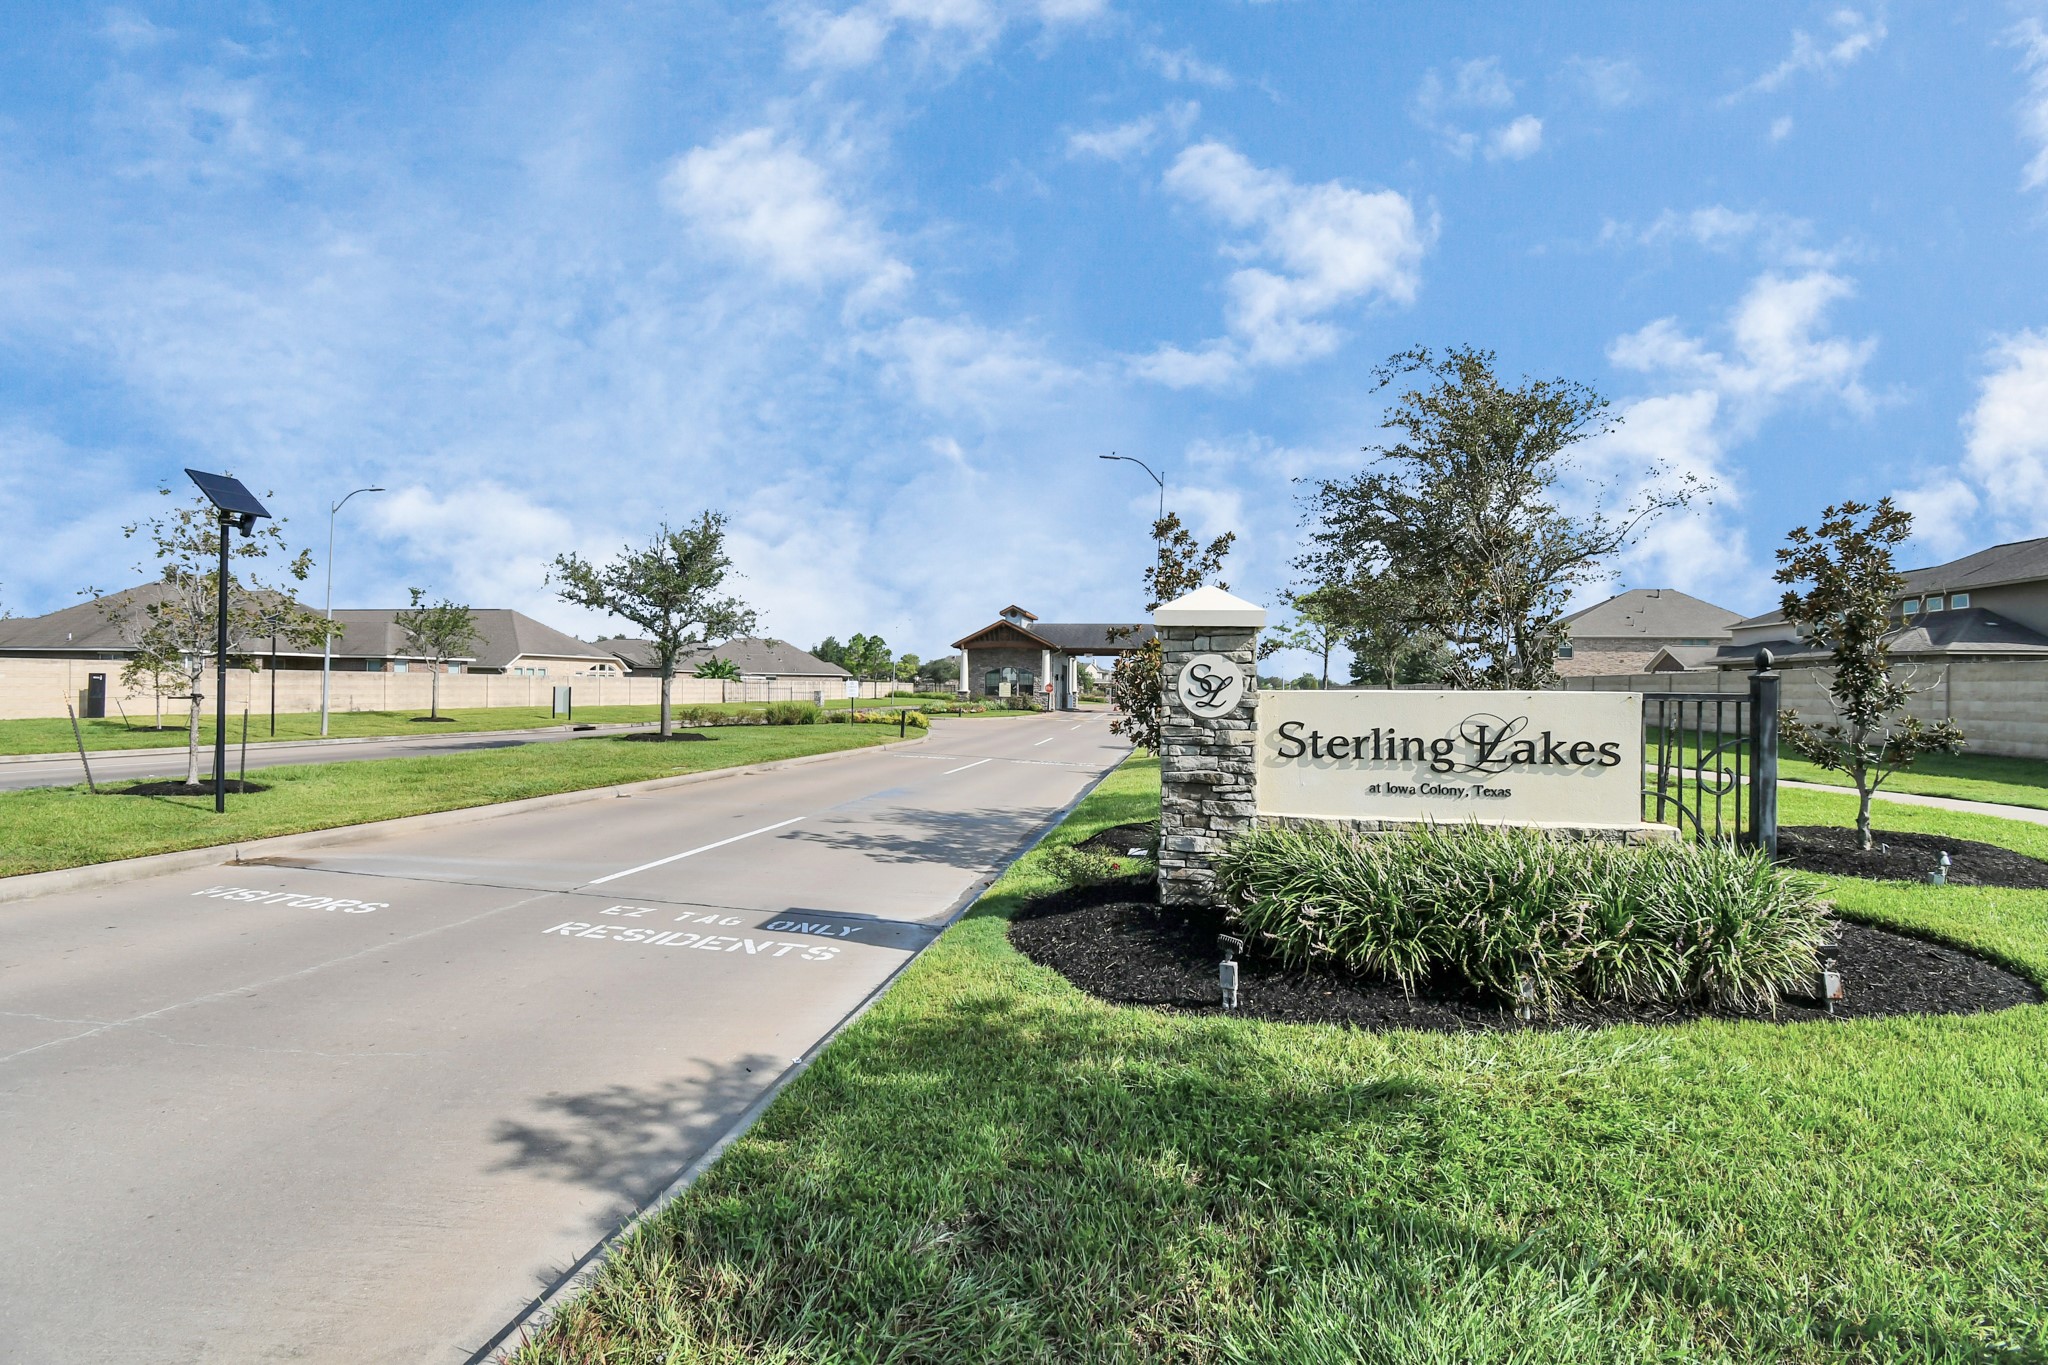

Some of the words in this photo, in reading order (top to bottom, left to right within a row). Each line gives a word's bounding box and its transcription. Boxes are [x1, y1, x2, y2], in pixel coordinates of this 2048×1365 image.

[1278, 721, 1455, 773] Sterling
[1453, 713, 1621, 773] Lakes
[1369, 783, 1381, 793] at
[1386, 782, 1416, 795] Iowa
[1420, 783, 1469, 799] Colony,
[1473, 785, 1512, 797] Texas
[191, 886, 389, 913] VISITORS
[600, 905, 658, 917] EZ
[673, 911, 746, 926] TAG
[766, 920, 864, 937] ONLY
[541, 921, 841, 961] RESIDENTS
